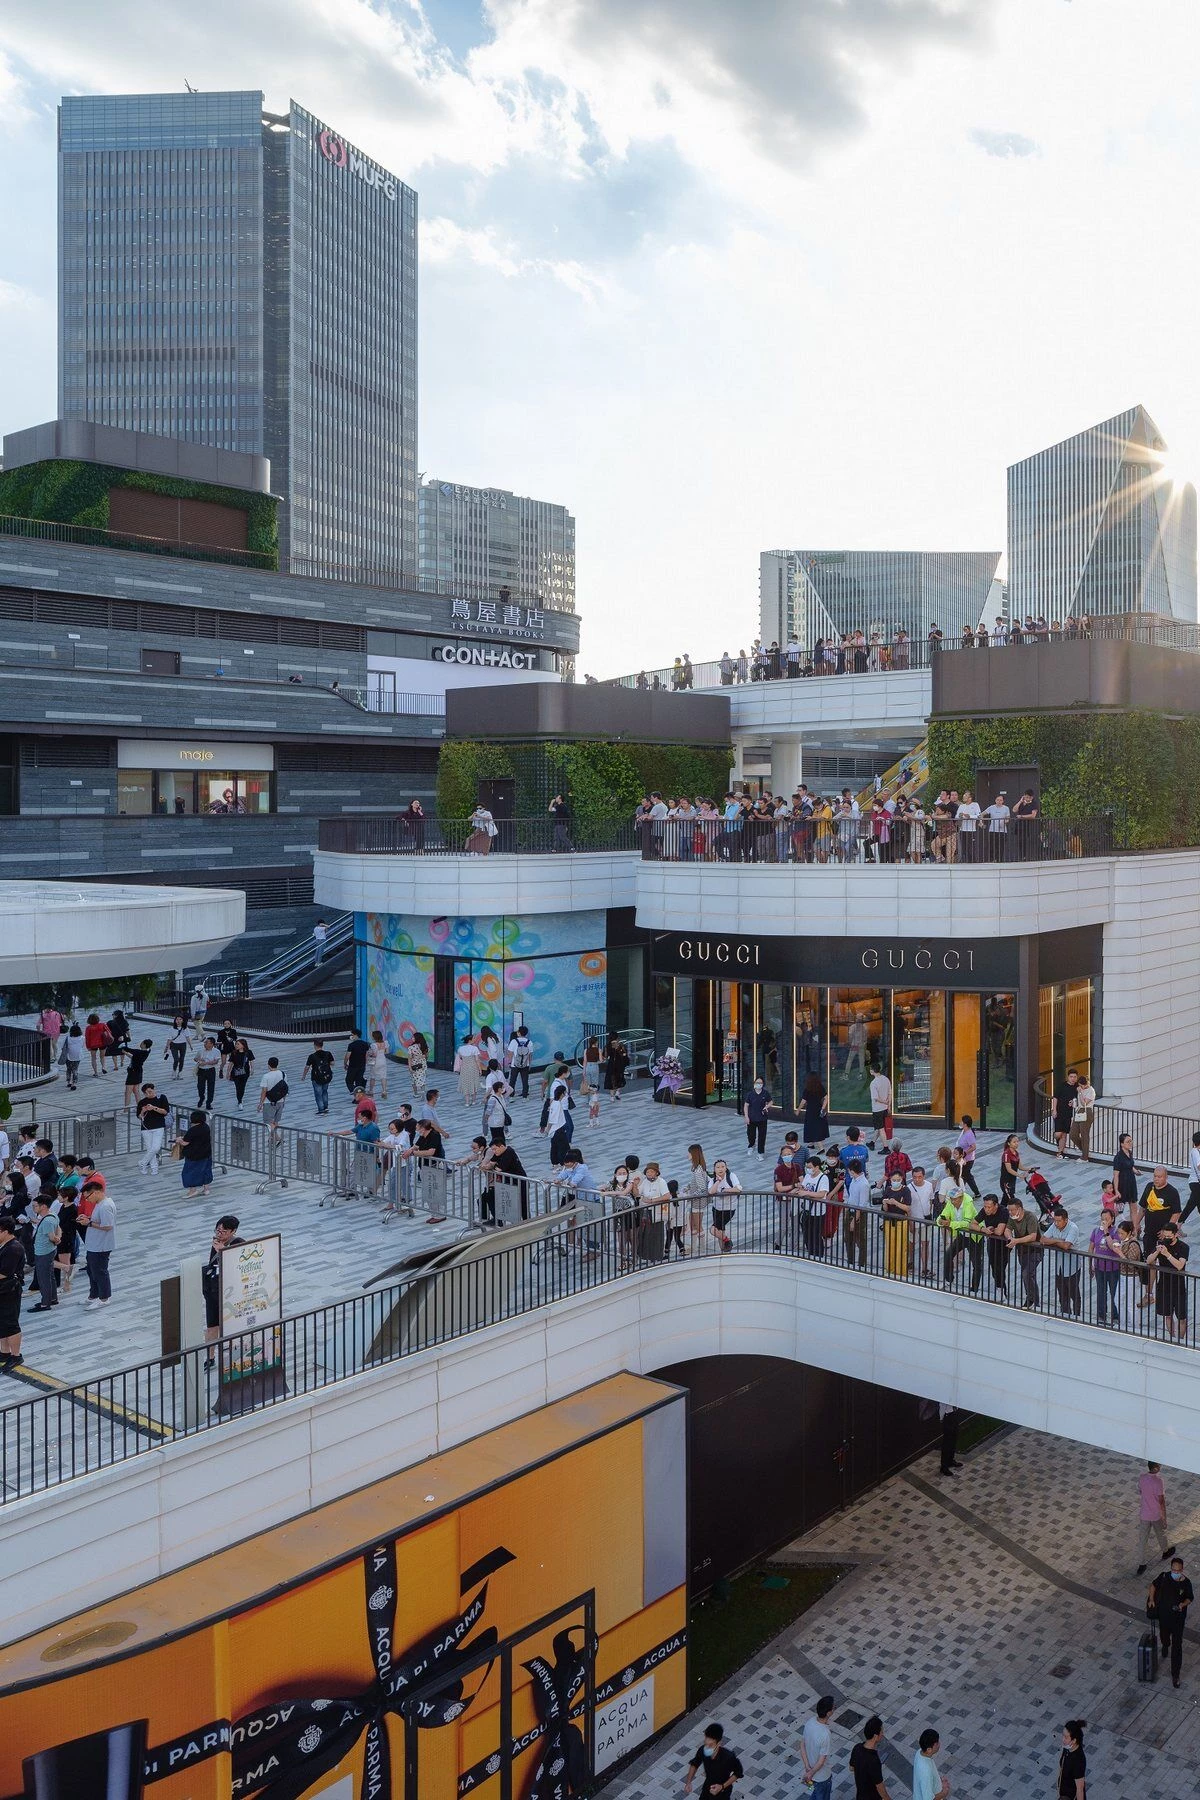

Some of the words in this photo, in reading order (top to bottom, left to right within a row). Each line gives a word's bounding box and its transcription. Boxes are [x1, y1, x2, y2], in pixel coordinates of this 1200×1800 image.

[349, 152, 396, 201] MUFG
[450, 598, 545, 629] 蔦屋書店
[450, 621, 502, 635] TSUTAYA
[508, 628, 545, 640] BOOKS
[679, 940, 760, 965] GUCCI
[861, 948, 975, 971] GUCCI
[414, 1659, 428, 1676] DI
[433, 1600, 483, 1658] PARMA
[643, 1638, 681, 1669] ACQUA
[597, 1688, 649, 1730] ACQUA
[618, 1714, 629, 1727] DI
[596, 1712, 649, 1755] PARMA
[367, 1726, 383, 1800] PARMA
